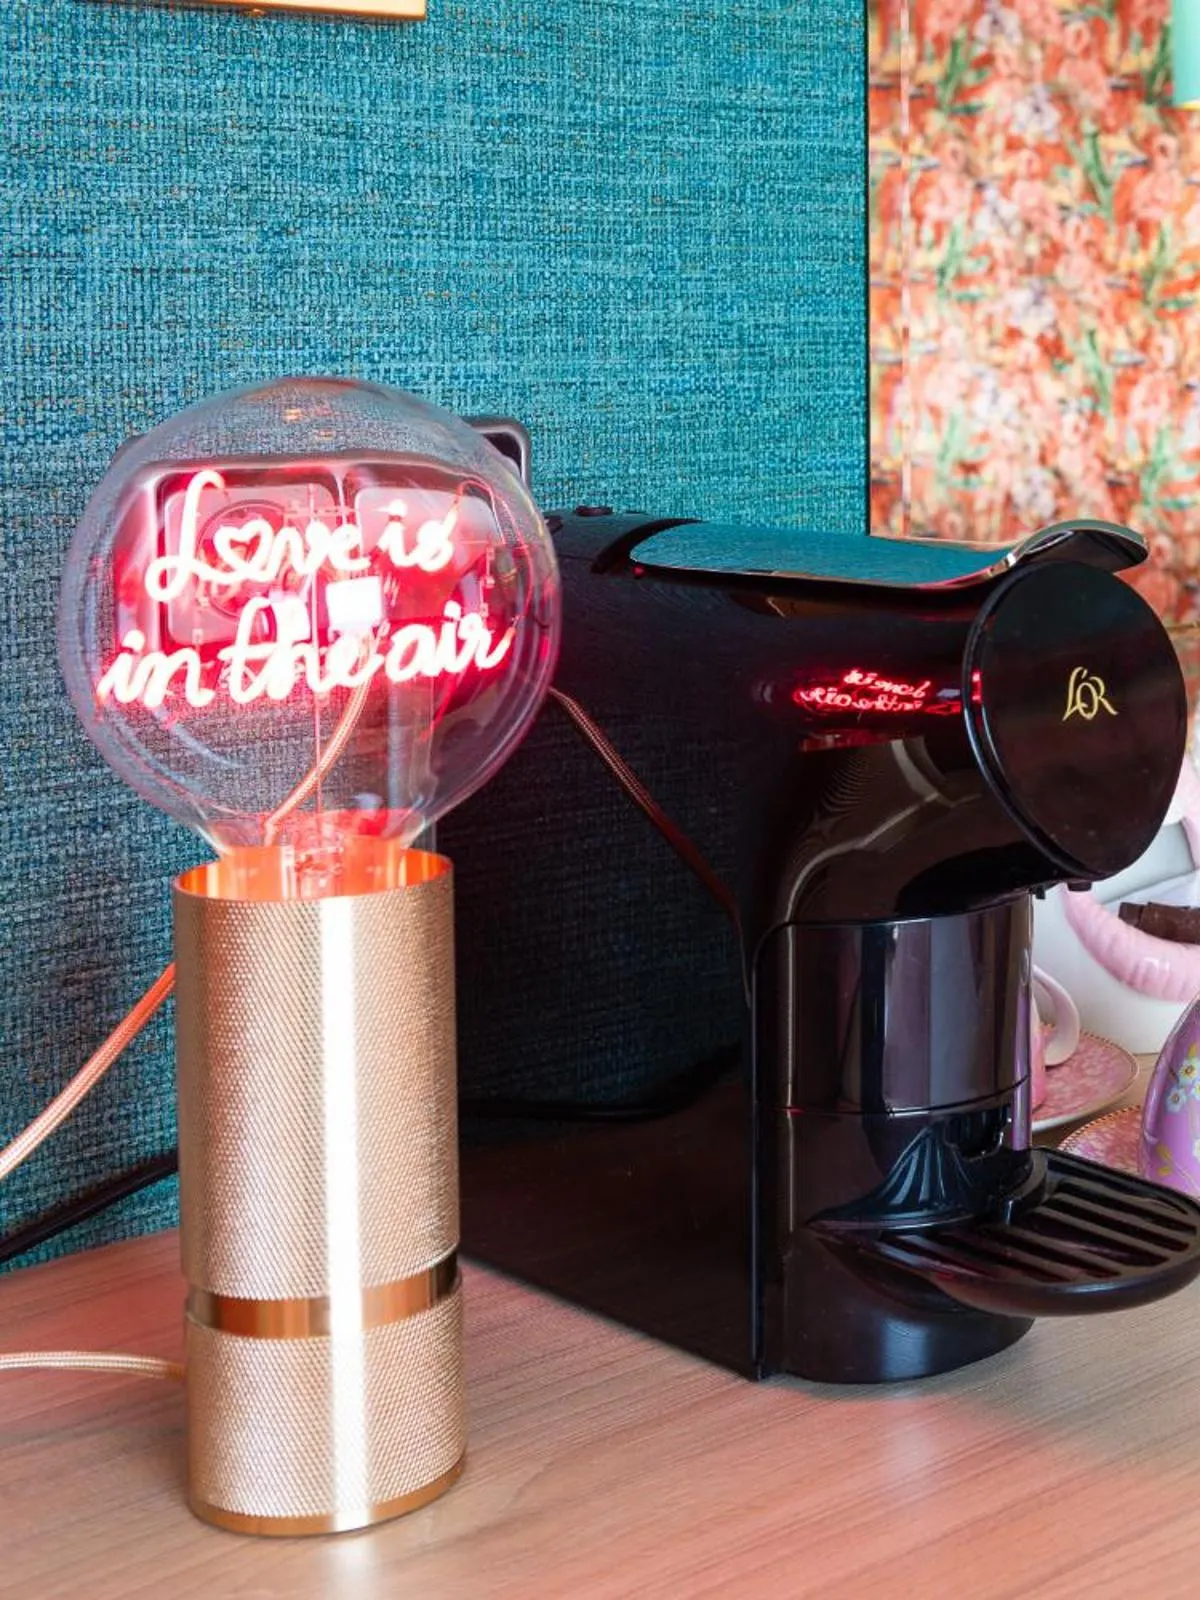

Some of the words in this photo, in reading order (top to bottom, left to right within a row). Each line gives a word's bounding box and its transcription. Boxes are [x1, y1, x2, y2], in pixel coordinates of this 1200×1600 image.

[144, 469, 371, 602] Love
[369, 499, 459, 573] is
[97, 628, 219, 708] in
[216, 596, 384, 706] the
[382, 600, 516, 682] air
